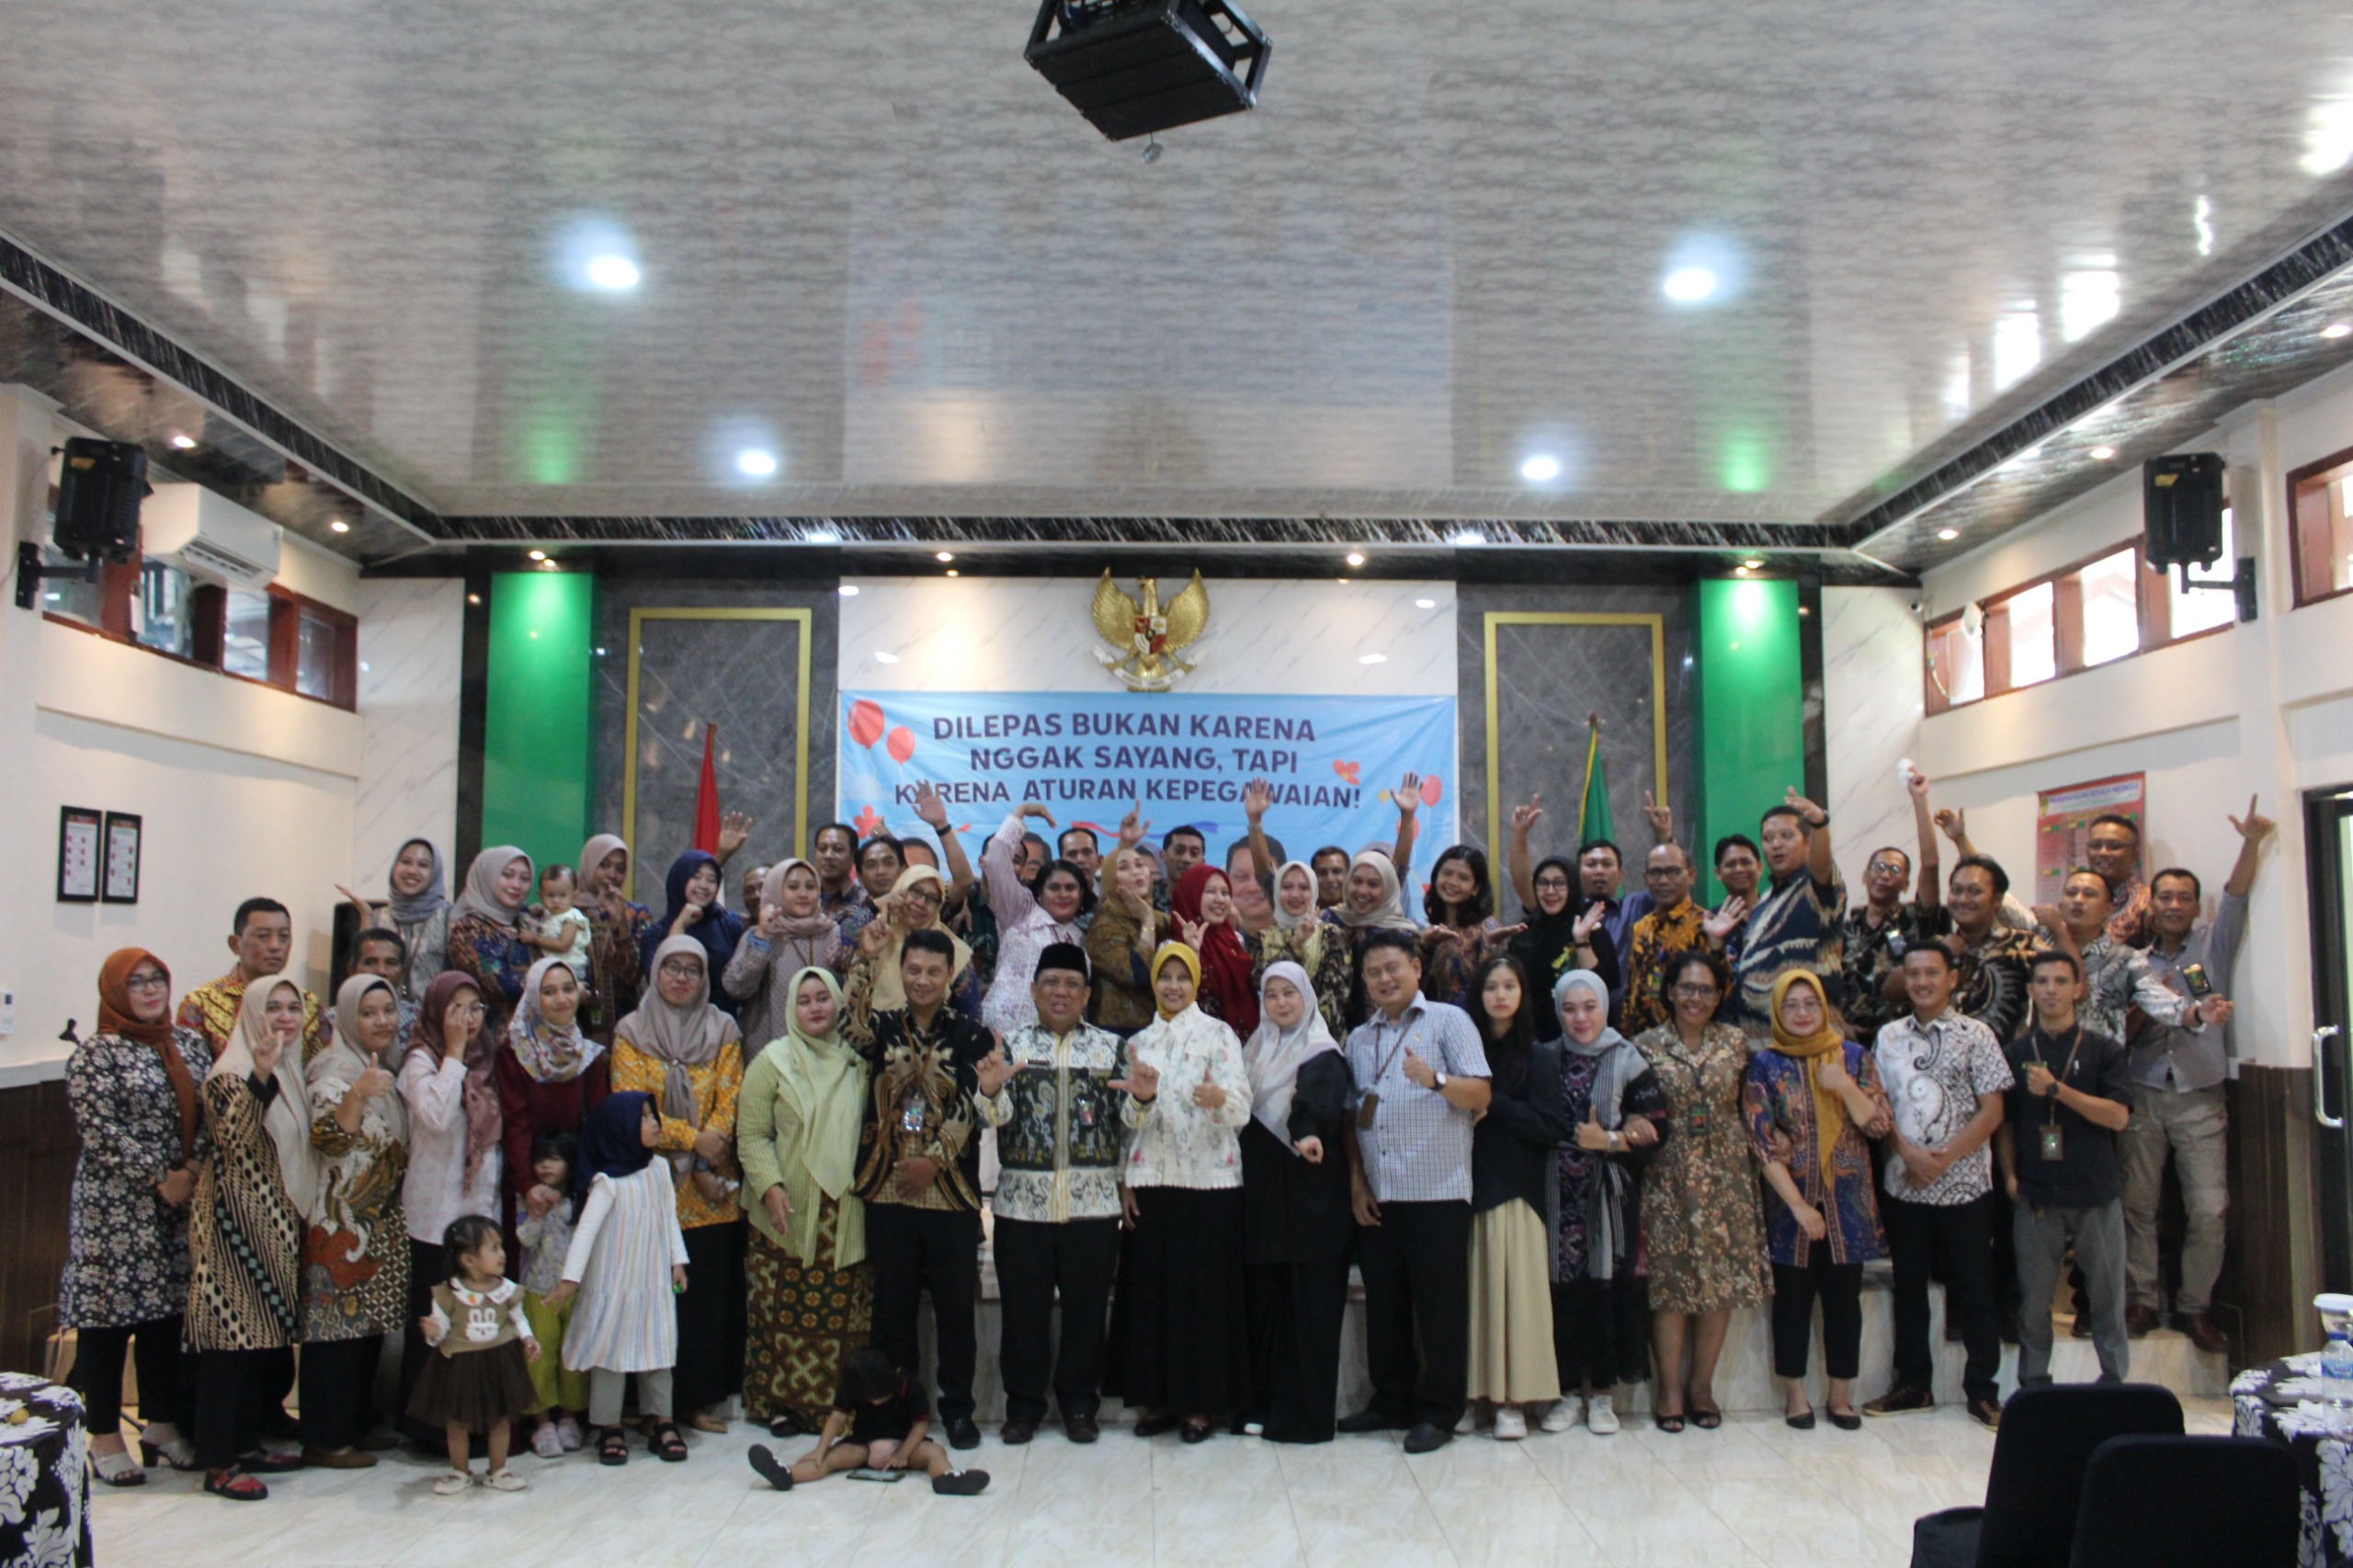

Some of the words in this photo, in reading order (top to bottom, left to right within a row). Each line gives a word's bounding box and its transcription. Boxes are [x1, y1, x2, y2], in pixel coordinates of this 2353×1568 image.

[933, 712, 1063, 740] DILEPAS
[1072, 712, 1180, 736] BUKAN
[1190, 714, 1315, 742] KARENA
[971, 746, 1085, 770] NGGAK
[1095, 745, 1223, 773] SAYANG,
[1233, 748, 1297, 773] TAPI
[895, 781, 1011, 805] KRENA
[1023, 778, 1136, 801] ATURAN
